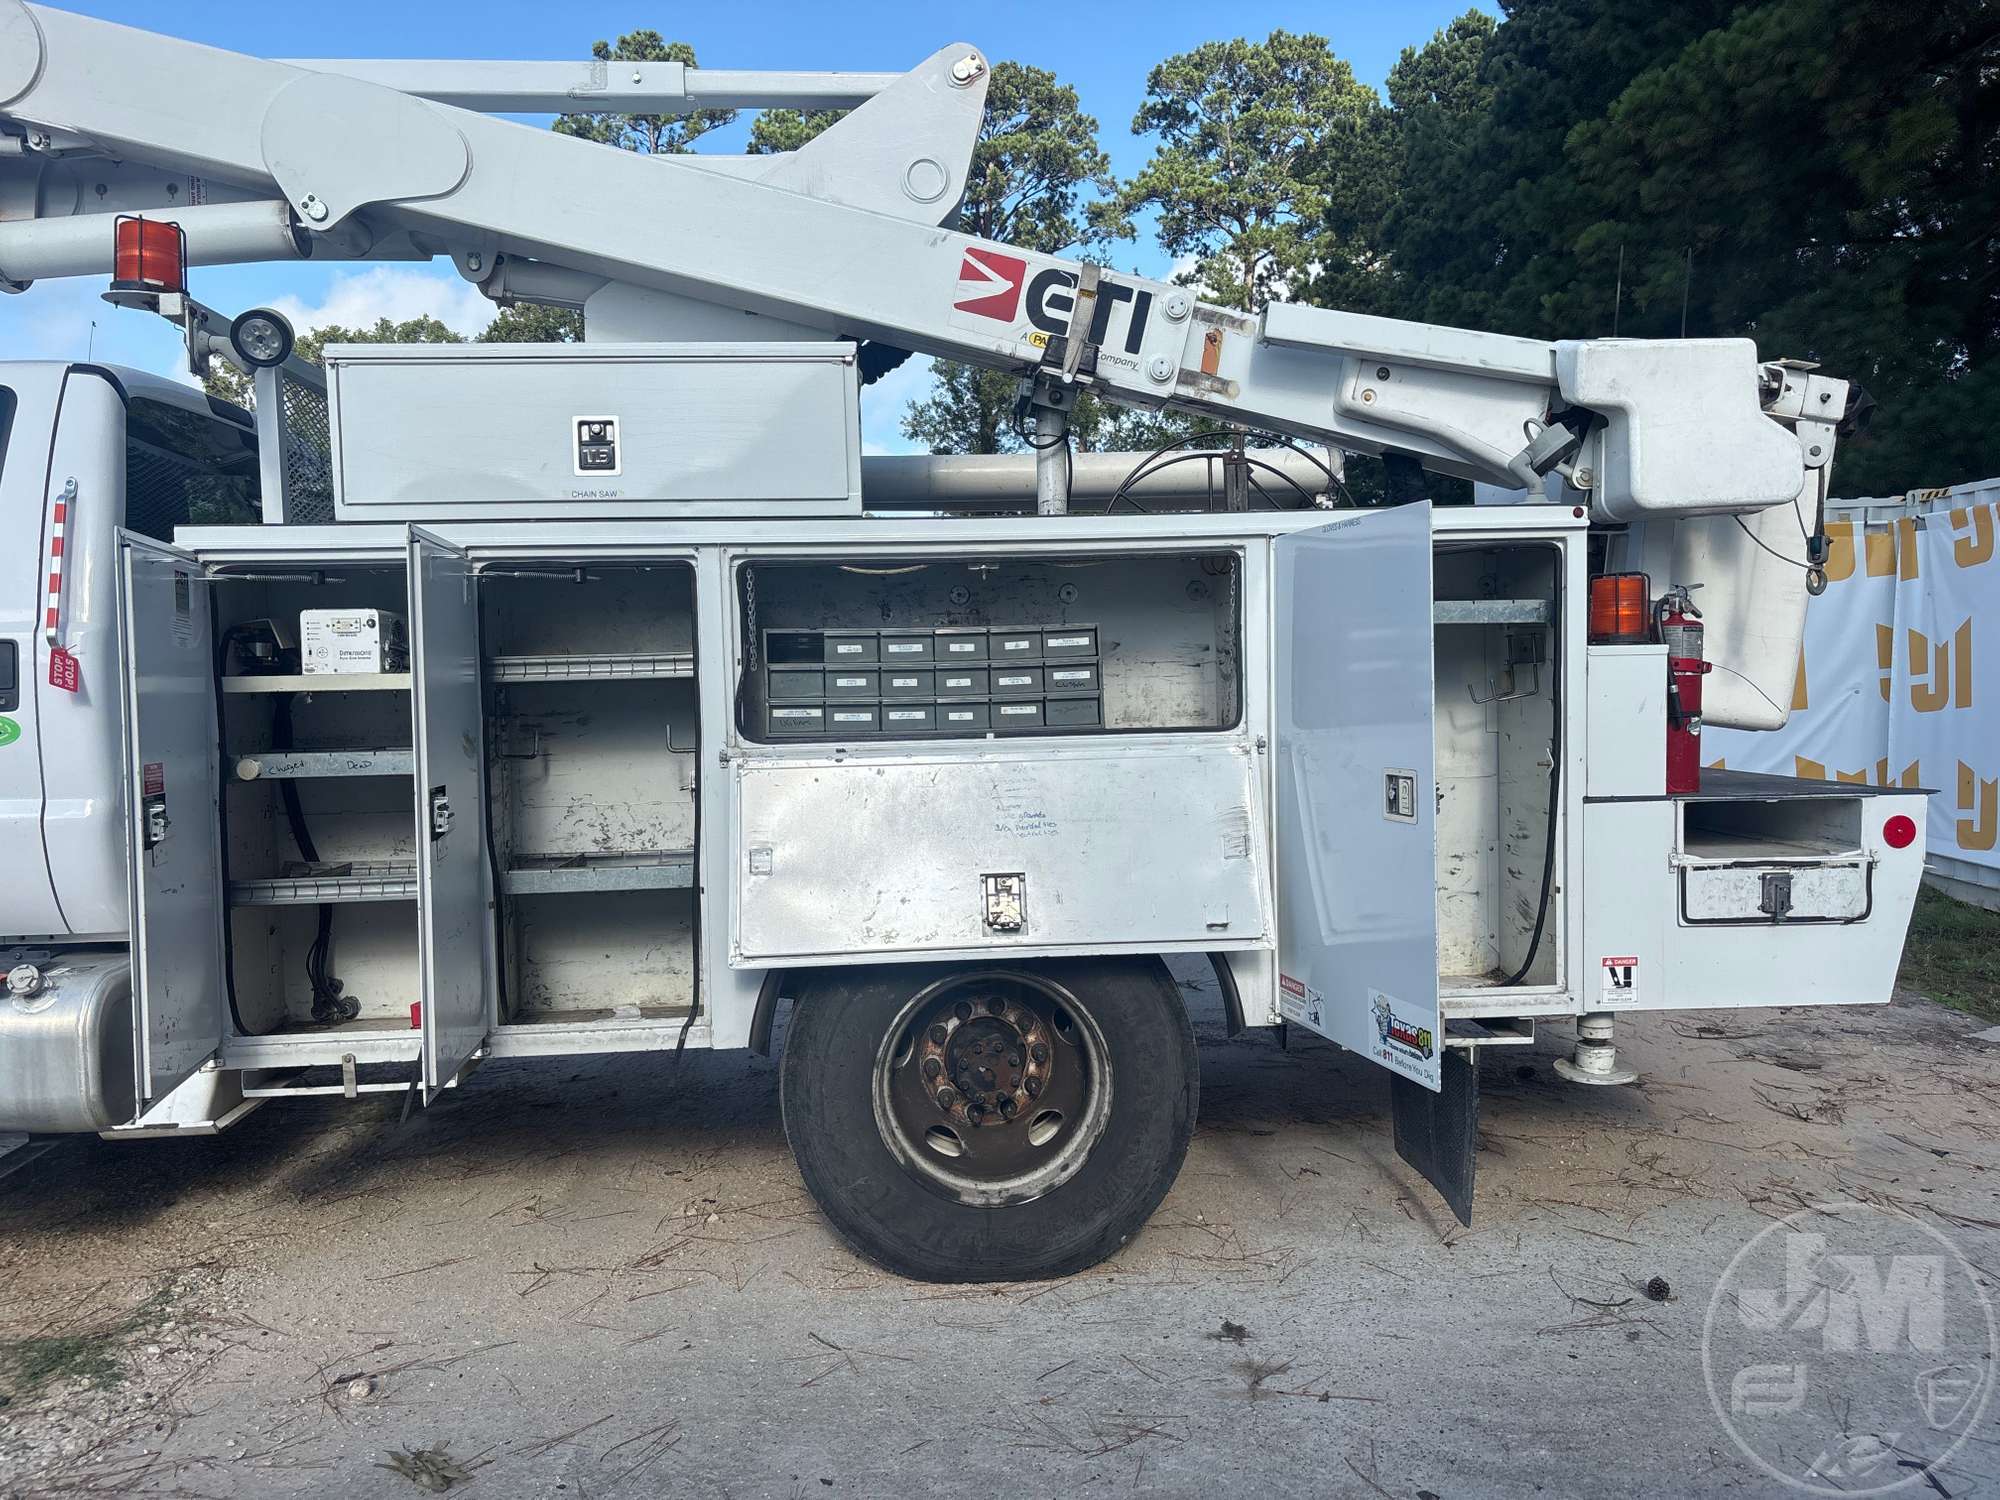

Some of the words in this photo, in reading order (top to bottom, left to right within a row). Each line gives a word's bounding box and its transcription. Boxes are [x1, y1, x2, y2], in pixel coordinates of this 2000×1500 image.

[1025, 268, 1153, 355] ETI
[571, 490, 597, 498] CHAIN
[598, 490, 618, 498] SAW
[53, 654, 64, 686] STOP!
[65, 658, 75, 689] STOP!
[1285, 977, 1304, 993] DANGER
[1390, 1013, 1418, 1044] Texas
[1418, 1027, 1432, 1050] 811
[1372, 1045, 1382, 1057] Call
[1382, 1048, 1394, 1062] 811
[1394, 1055, 1412, 1071] Before
[1412, 1061, 1423, 1077] You
[1423, 1068, 1435, 1083] Dig
